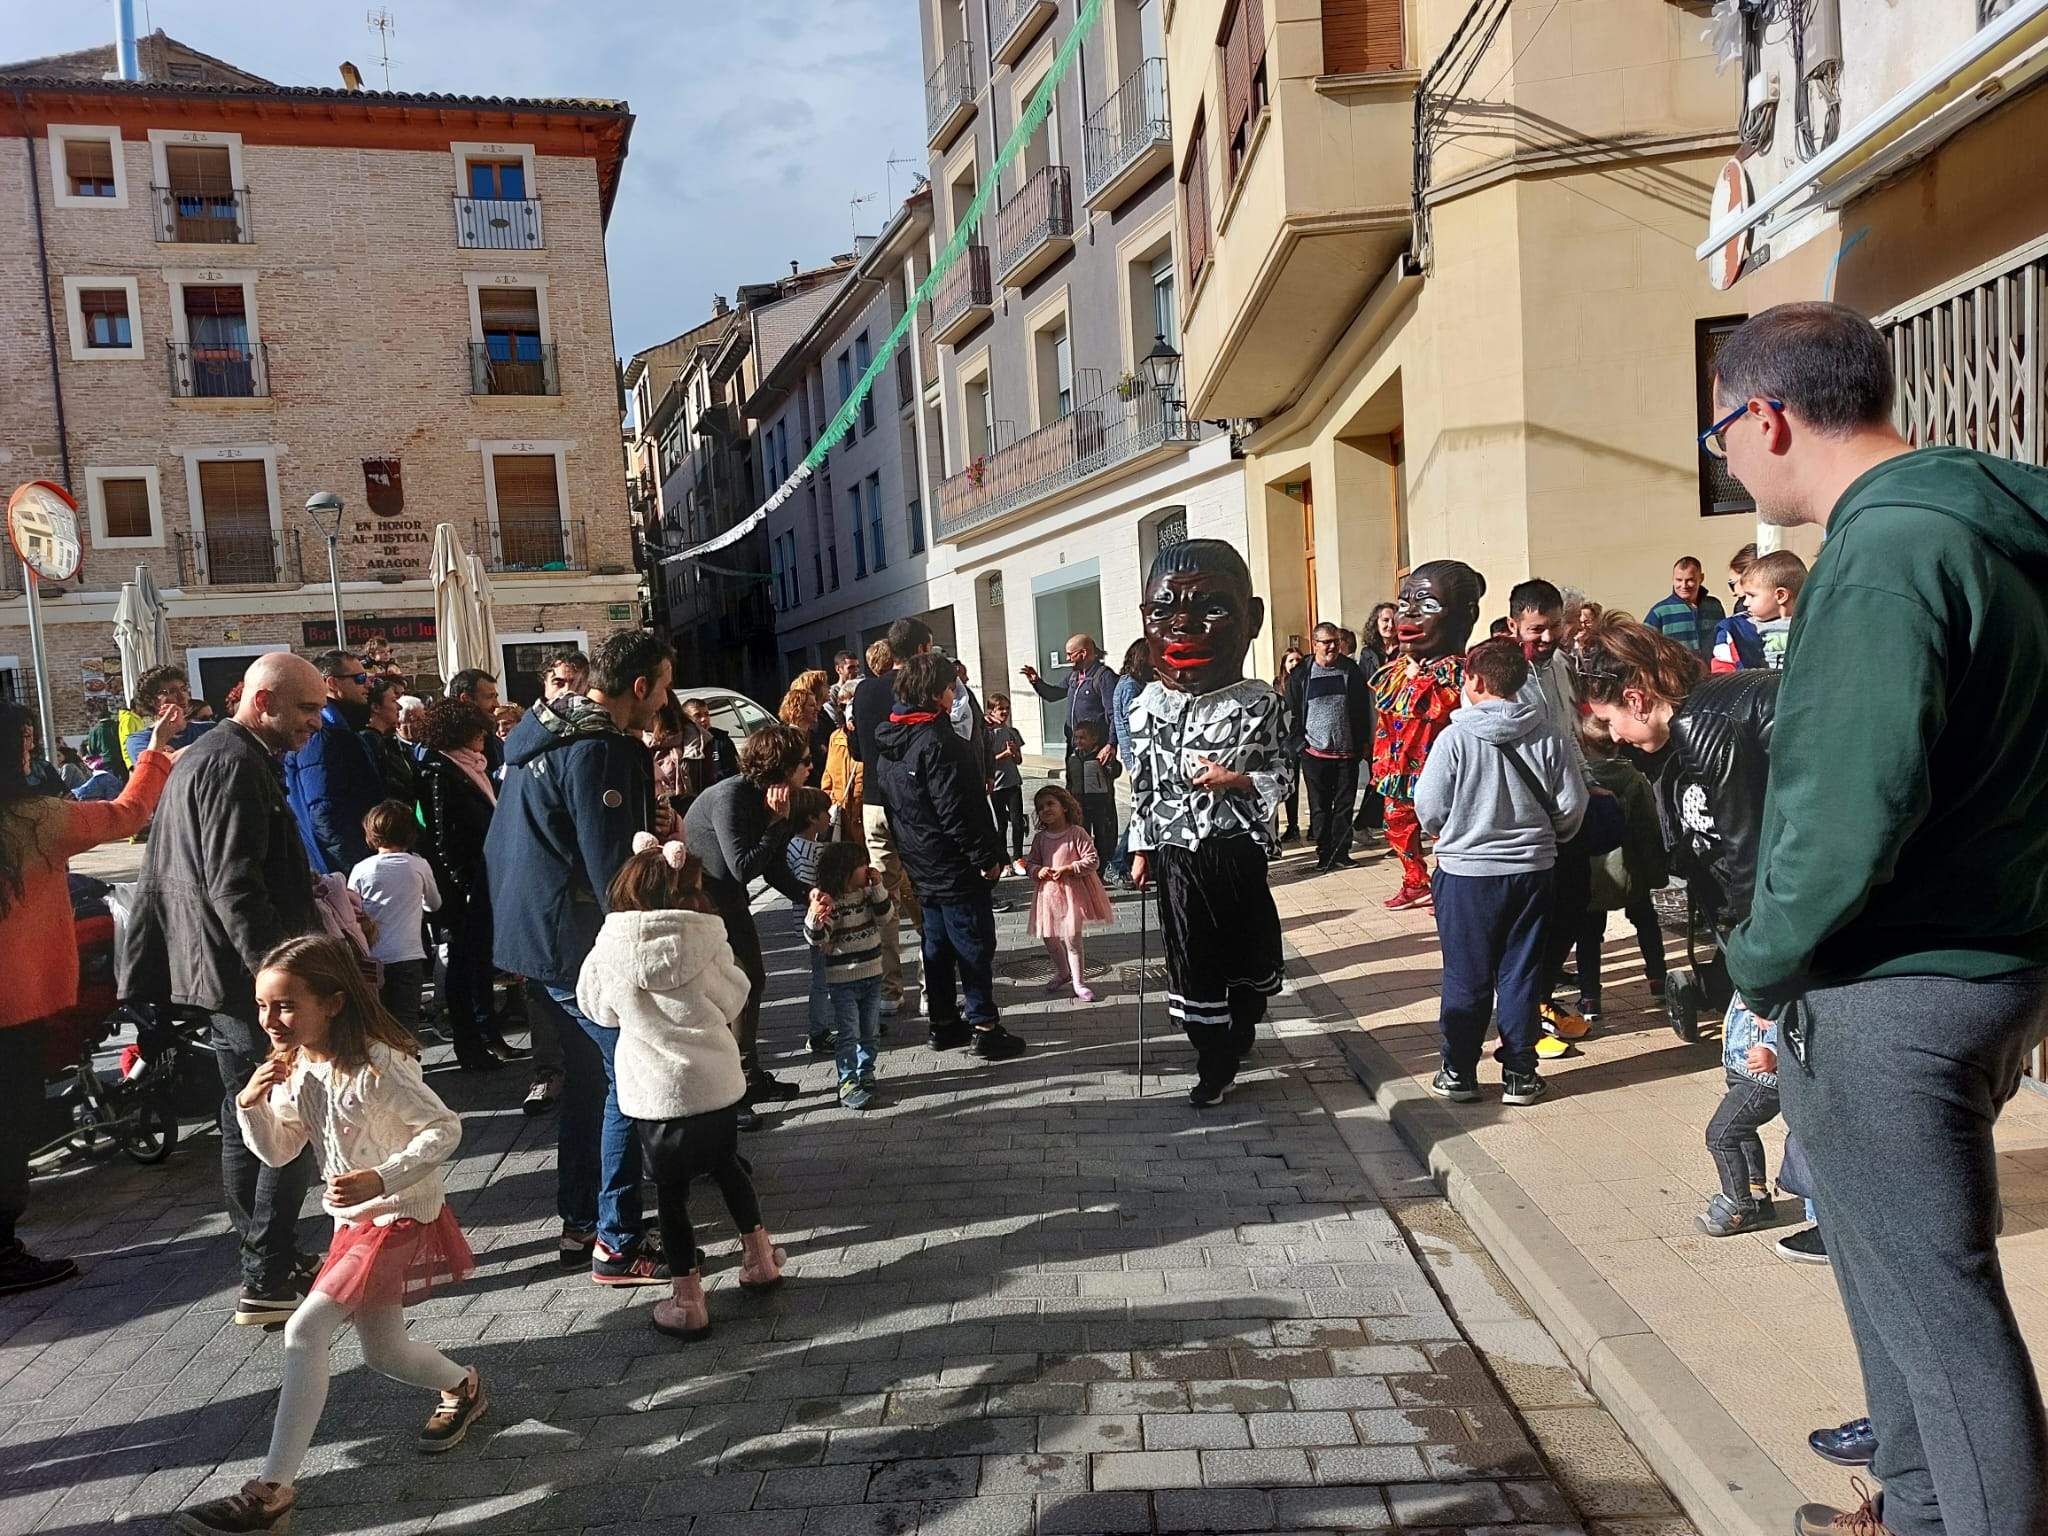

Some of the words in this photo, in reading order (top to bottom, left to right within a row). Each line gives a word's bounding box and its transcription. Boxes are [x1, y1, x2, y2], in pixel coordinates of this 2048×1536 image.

[355, 521, 372, 532] EN
[377, 520, 422, 531] HONOR
[367, 558, 420, 569] ARAGON
[347, 624, 385, 640] Plaza
[392, 623, 413, 637] del
